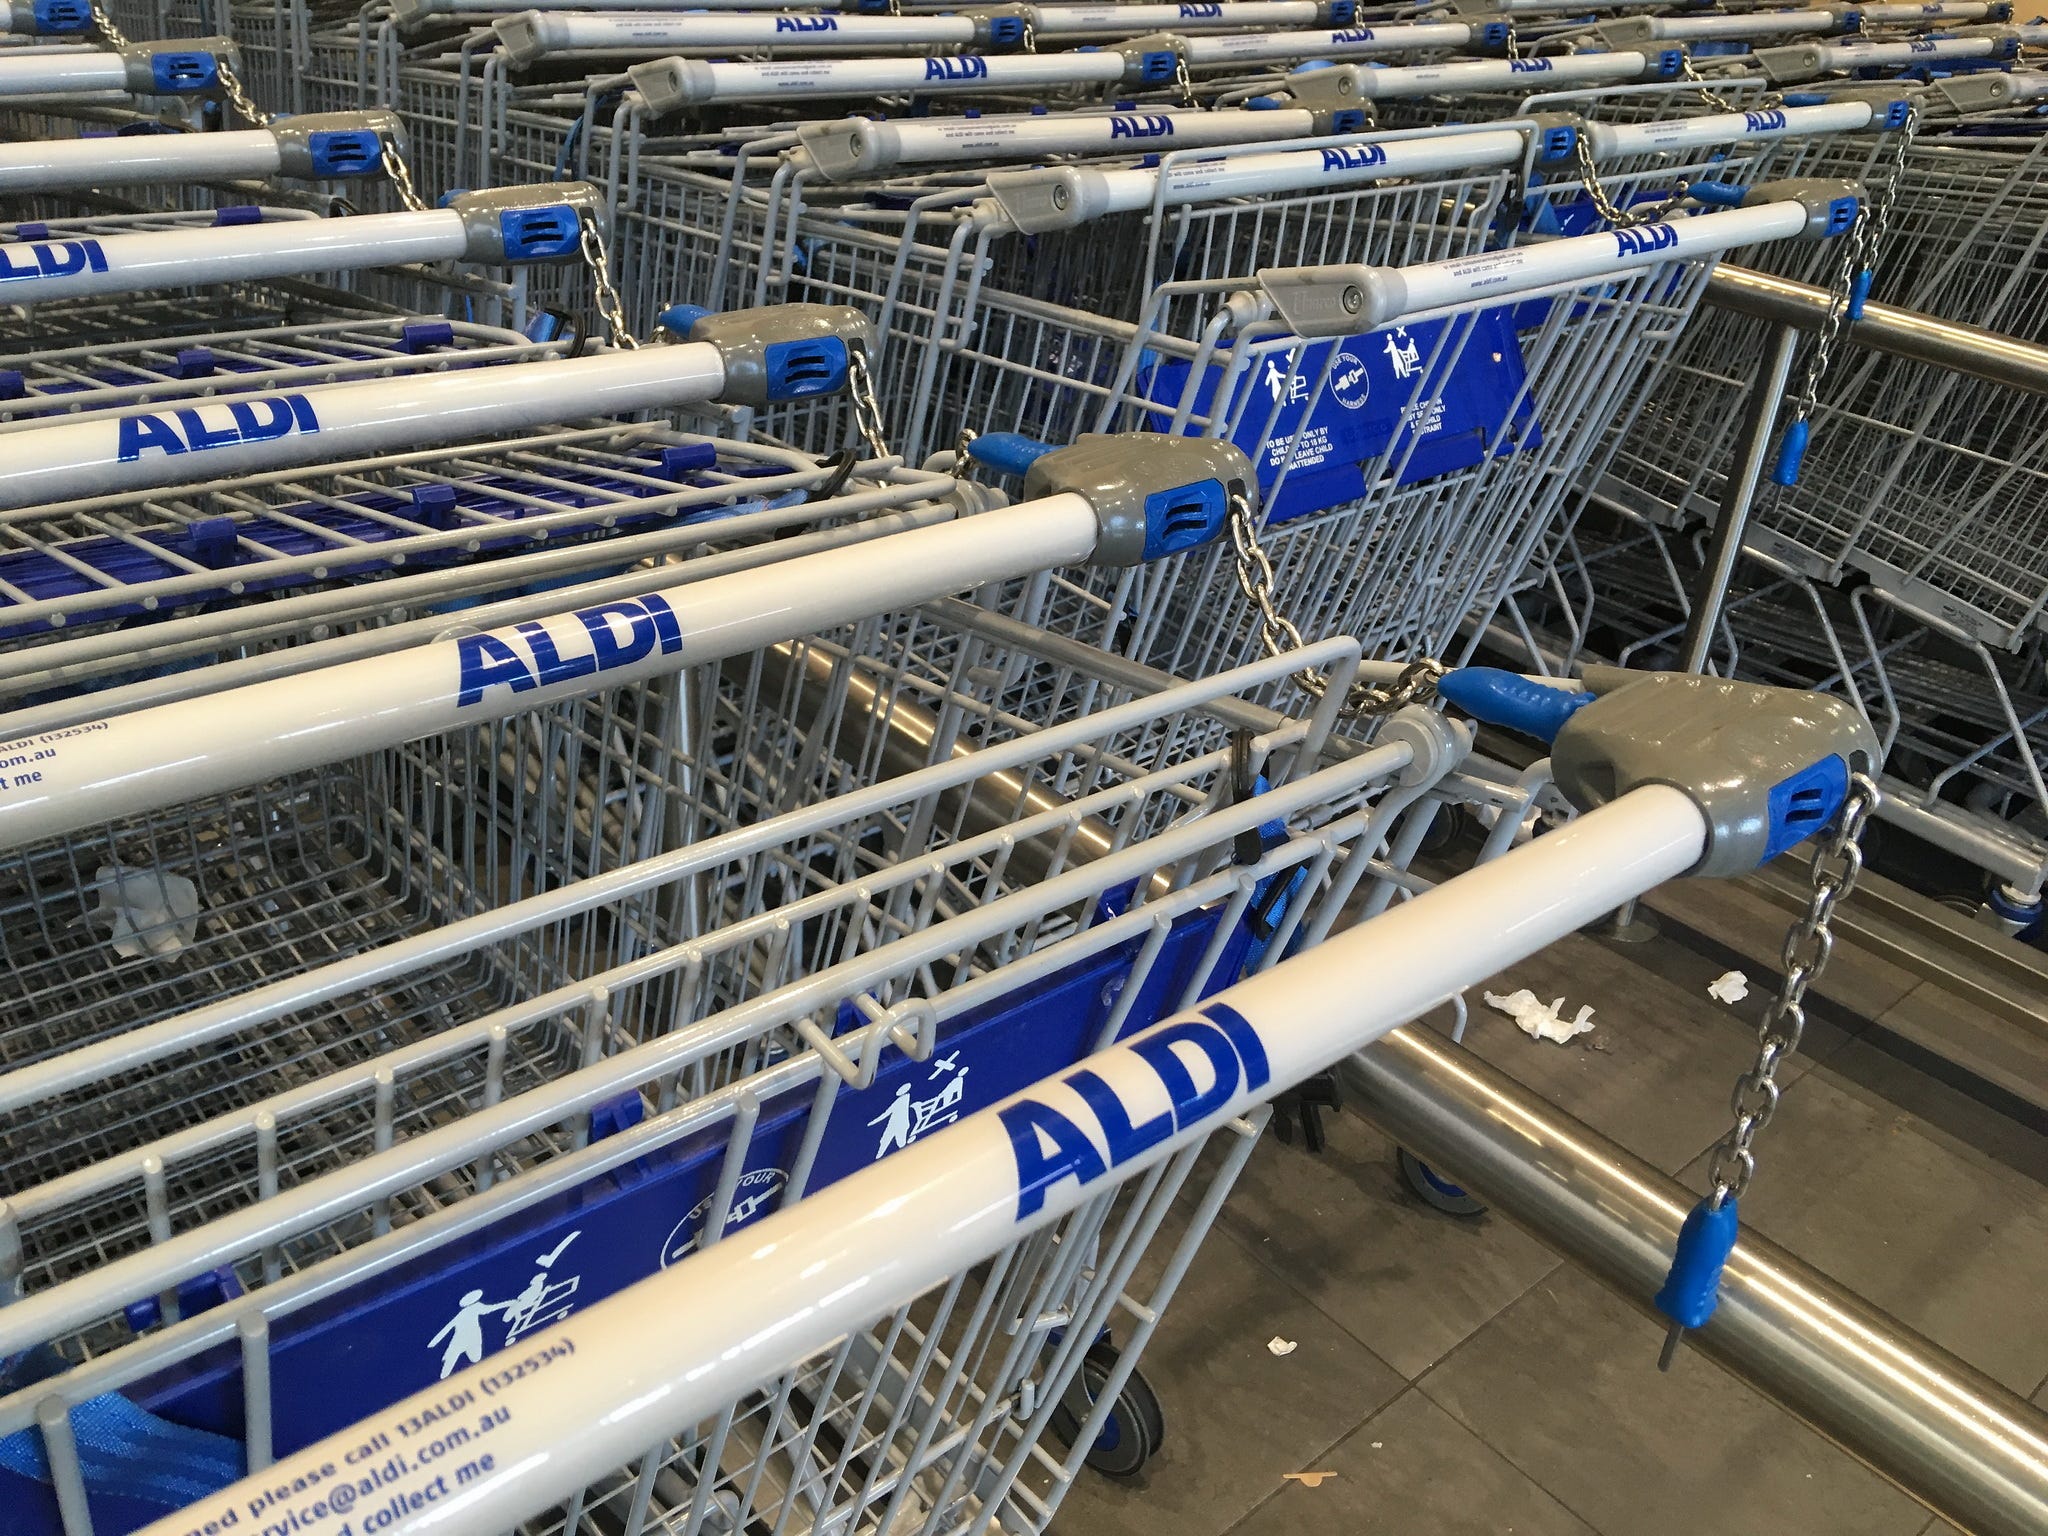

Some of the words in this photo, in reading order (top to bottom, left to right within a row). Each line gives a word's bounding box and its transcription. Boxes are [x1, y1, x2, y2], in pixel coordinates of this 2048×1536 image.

[775, 17, 838, 33] ALDI
[924, 54, 987, 81] ALDI
[1110, 114, 1174, 139] ALDI
[1745, 109, 1787, 132] ALDI
[1320, 143, 1387, 172] ALDI
[1614, 222, 1679, 258] ALDI
[117, 394, 320, 463] ALDI
[1320, 426, 1329, 436] BY
[456, 593, 684, 708] ALDI
[39, 721, 109, 744] (132534)
[14, 771, 43, 788] me
[998, 1001, 1270, 1223] ALDI
[248, 1462, 337, 1518] please
[344, 1432, 391, 1465] call
[396, 1389, 476, 1439] 13ALDI
[479, 1337, 576, 1396] (132534)
[362, 1475, 450, 1535] collect
[454, 1453, 496, 1485] me
